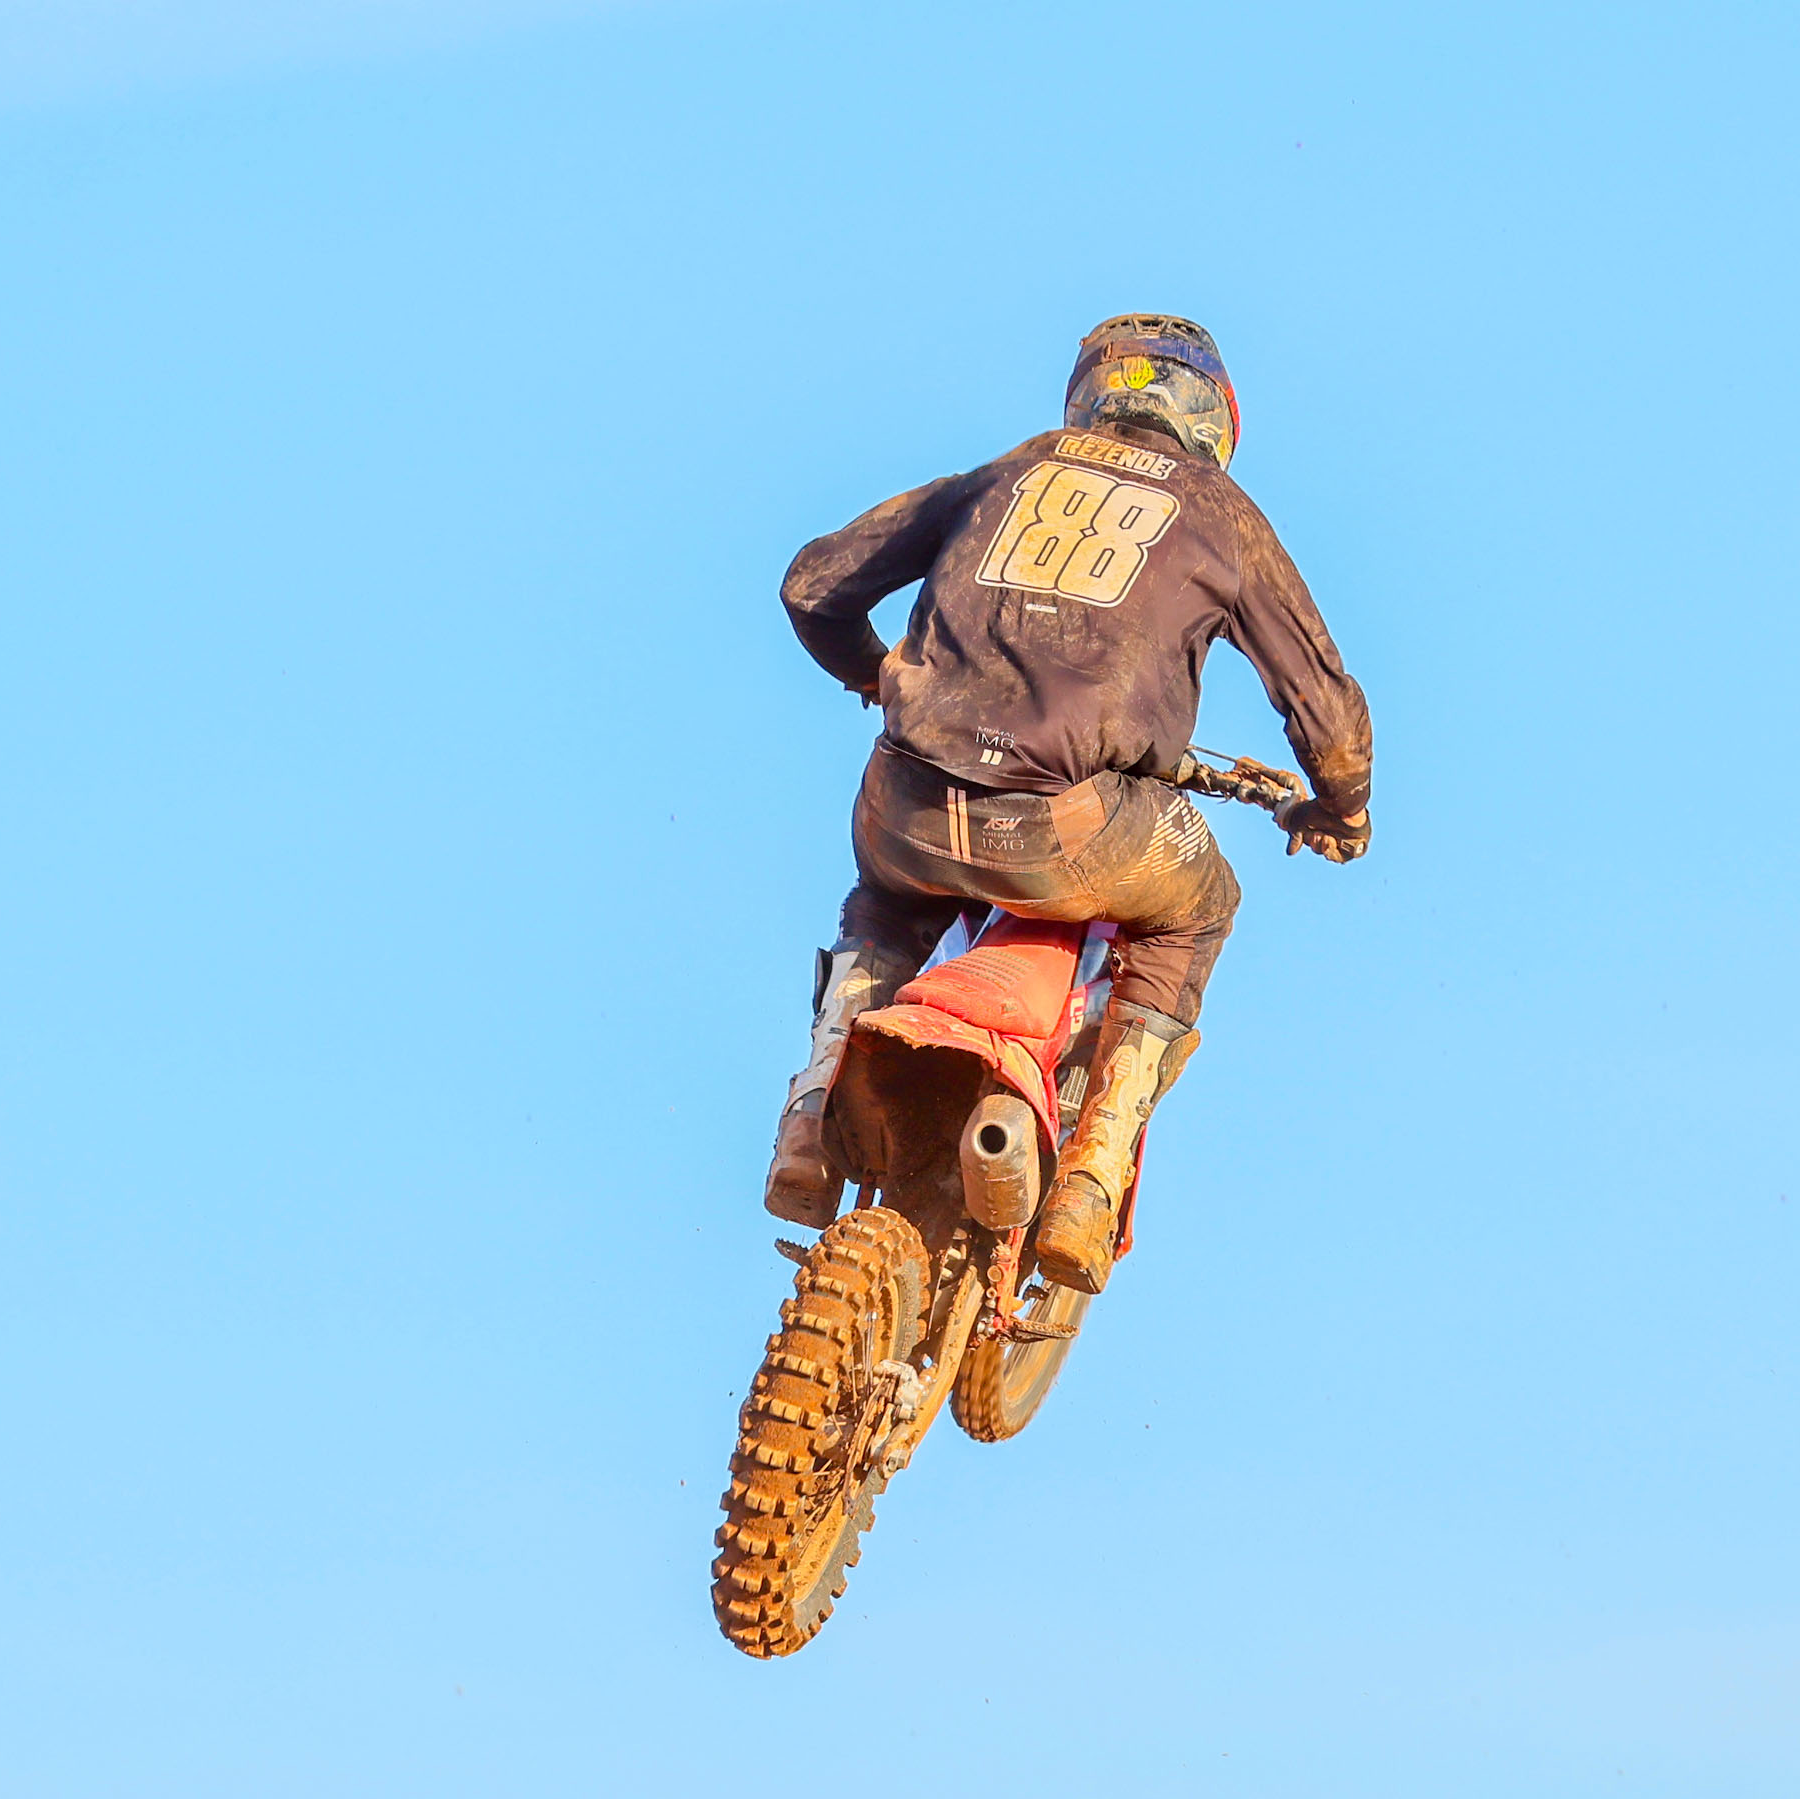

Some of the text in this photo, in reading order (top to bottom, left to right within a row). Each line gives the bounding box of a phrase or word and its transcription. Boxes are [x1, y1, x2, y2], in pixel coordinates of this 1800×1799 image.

[1060, 438, 1171, 478] REZENDE
[975, 461, 1180, 607] 188
[975, 732, 1015, 749] IMG
[982, 838, 1025, 850] IMG
